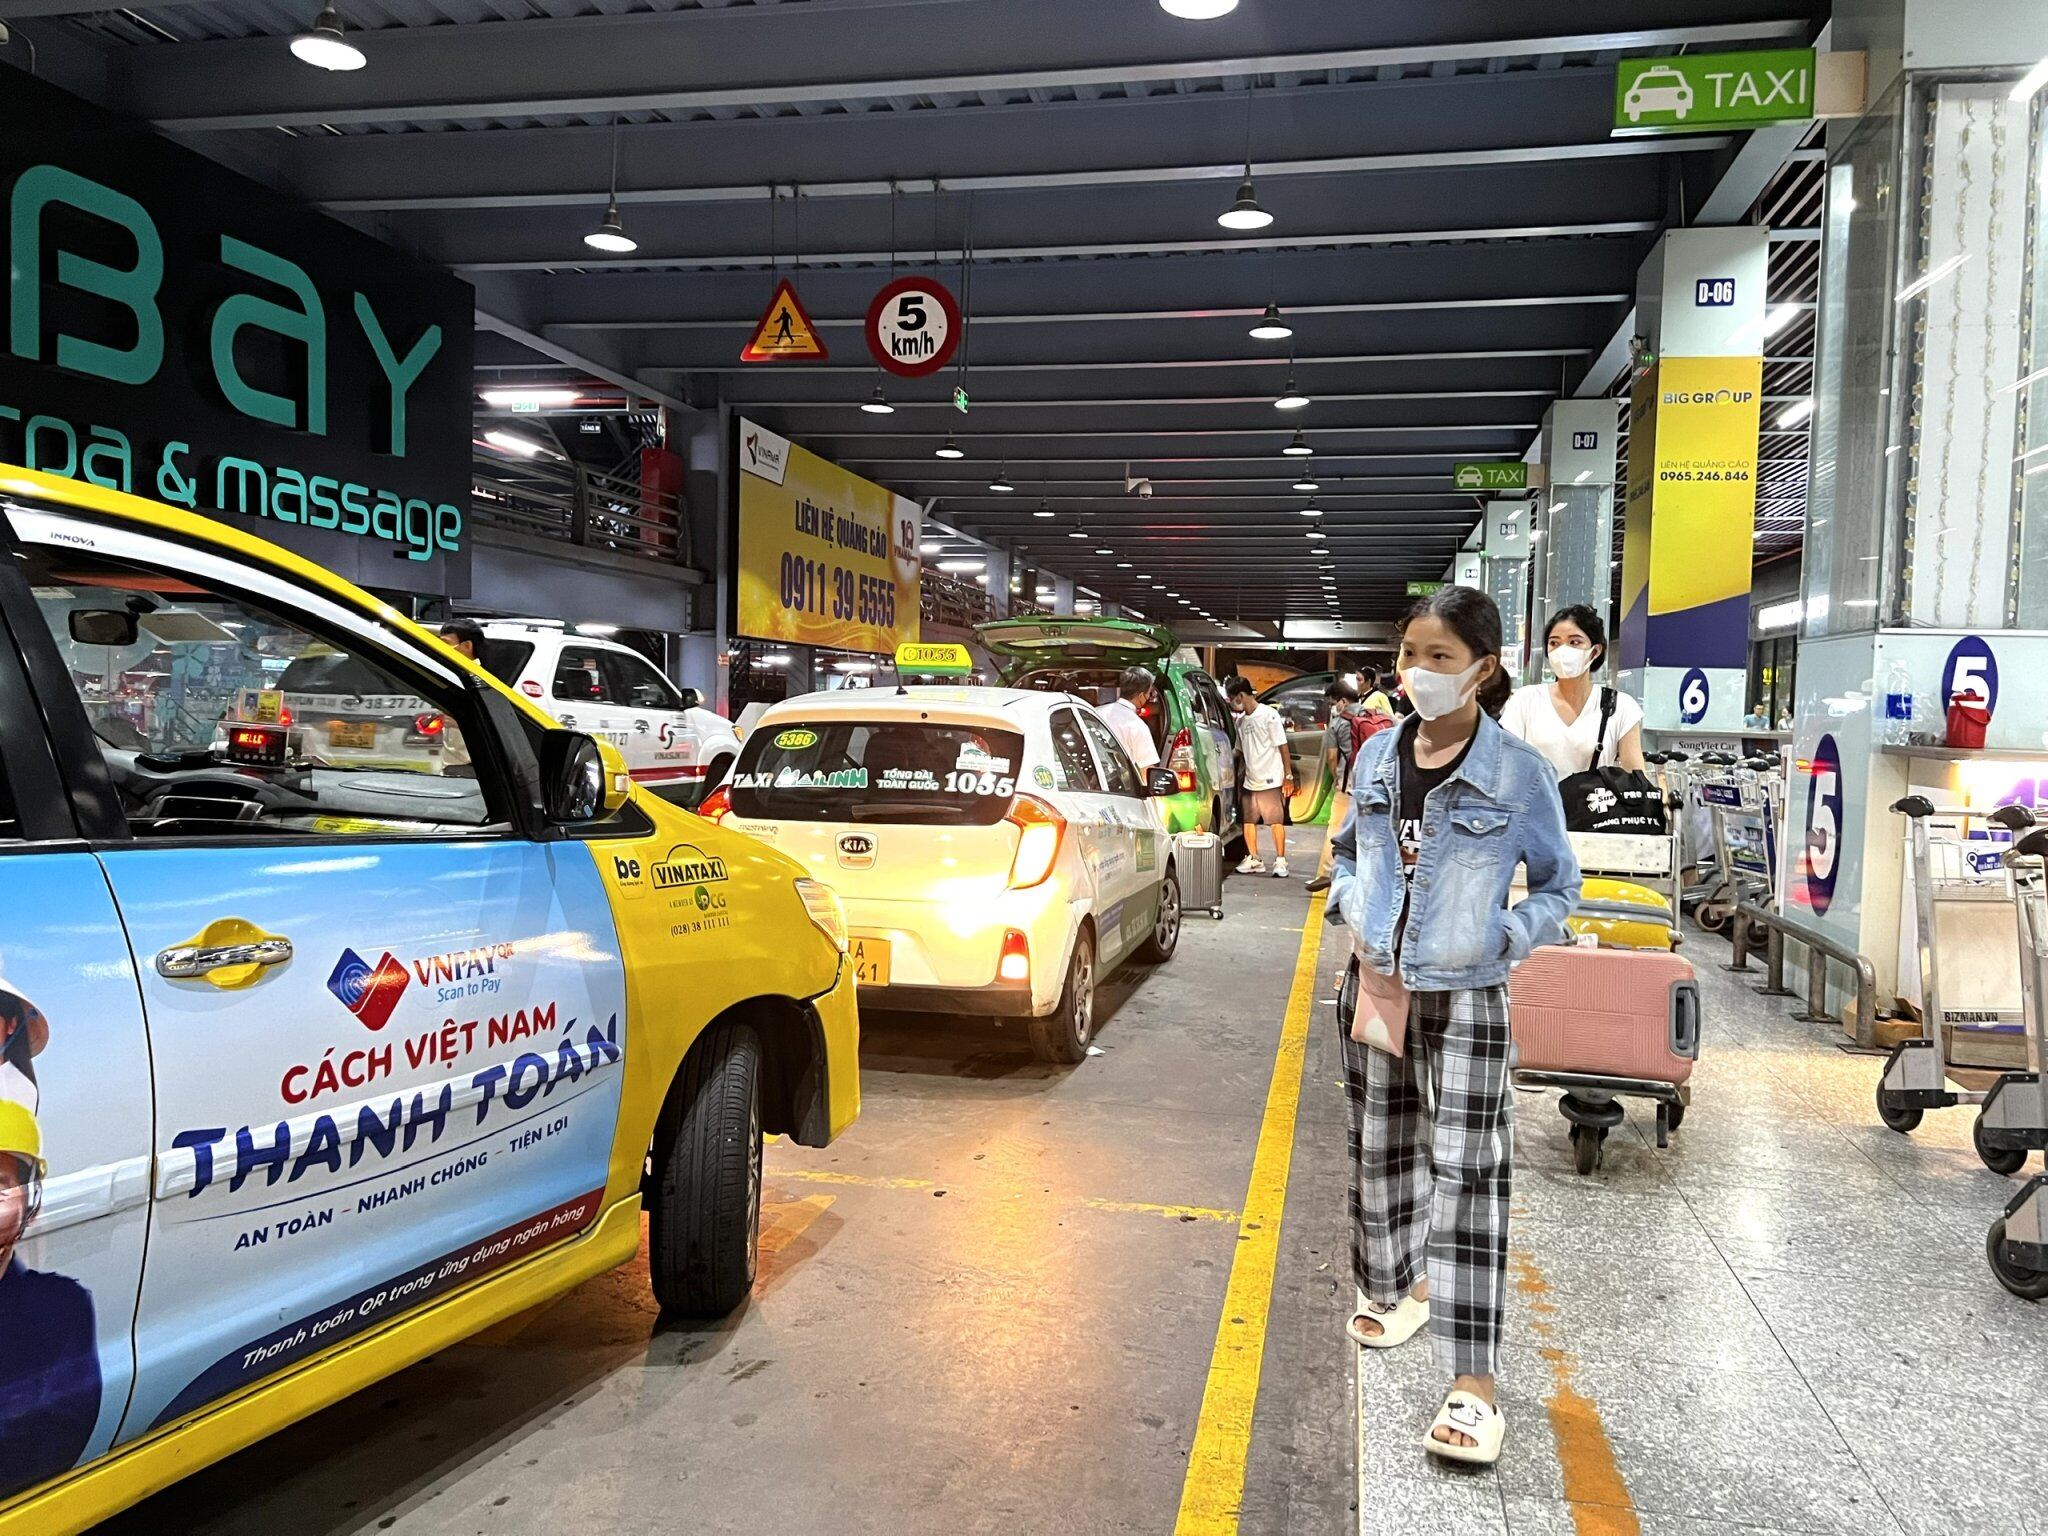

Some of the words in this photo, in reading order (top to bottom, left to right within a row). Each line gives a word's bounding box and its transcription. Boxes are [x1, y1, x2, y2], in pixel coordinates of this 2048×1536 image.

[1705, 69, 1807, 108] TAXI
[1699, 281, 1733, 304] D-06
[896, 295, 927, 331] 5
[892, 330, 934, 358] km/h
[1663, 392, 1689, 404] BIG
[1693, 389, 1753, 406] GROUP
[1574, 434, 1595, 448] D-07
[1486, 469, 1524, 484] TAXI
[1660, 461, 1678, 469] LIÊN
[1660, 471, 1749, 481] 0965.246.846
[0, 404, 132, 494] pa
[156, 440, 197, 509] &
[216, 456, 462, 561] massage
[50, 531, 96, 547] INNOVA
[795, 497, 819, 538] LIÊN
[821, 506, 834, 549] HỆ
[836, 511, 868, 554] QUẢNG
[869, 525, 887, 560] CÁO
[780, 551, 826, 616] 0911
[833, 566, 854, 622] 39
[858, 572, 896, 629] 5555
[918, 648, 957, 662] 1055
[1949, 656, 1991, 711] 5
[1682, 679, 1706, 715] 6
[777, 732, 812, 746] 5386
[1720, 742, 1736, 751] Car
[944, 771, 1015, 798] 1055
[1623, 790, 1662, 800] PROECT
[1810, 771, 1837, 880] 5
[843, 839, 867, 851] KIA
[613, 855, 641, 879] be
[656, 861, 724, 884] VINATAXI
[671, 923, 690, 938] (028)
[692, 921, 701, 932] 38
[704, 918, 716, 931] 111
[718, 916, 730, 927] 111
[438, 985, 464, 1003] Scan
[467, 982, 478, 995] to
[482, 977, 501, 994] Pay
[1944, 1011, 1999, 1023] BIZMAN.VN
[280, 1043, 392, 1104] CÁCH
[405, 1018, 479, 1070] VIỆT
[488, 1001, 557, 1048] NAM
[172, 1082, 453, 1199] THANH
[471, 1012, 623, 1127] TOÁN
[234, 1226, 269, 1252] AN
[275, 1206, 333, 1240] TOÀN
[357, 1176, 426, 1215] NHANH
[430, 1150, 489, 1188] CHÓNG
[509, 1124, 543, 1153] TIỆN
[546, 1115, 569, 1137] LỢI
[241, 1327, 306, 1371] Thanh
[310, 1308, 355, 1340] toán
[358, 1290, 387, 1317] QR
[388, 1270, 436, 1303] trong
[438, 1255, 470, 1280] ứng
[472, 1237, 512, 1265] dụng
[513, 1220, 549, 1248] ngân
[550, 1203, 586, 1229] hàng
